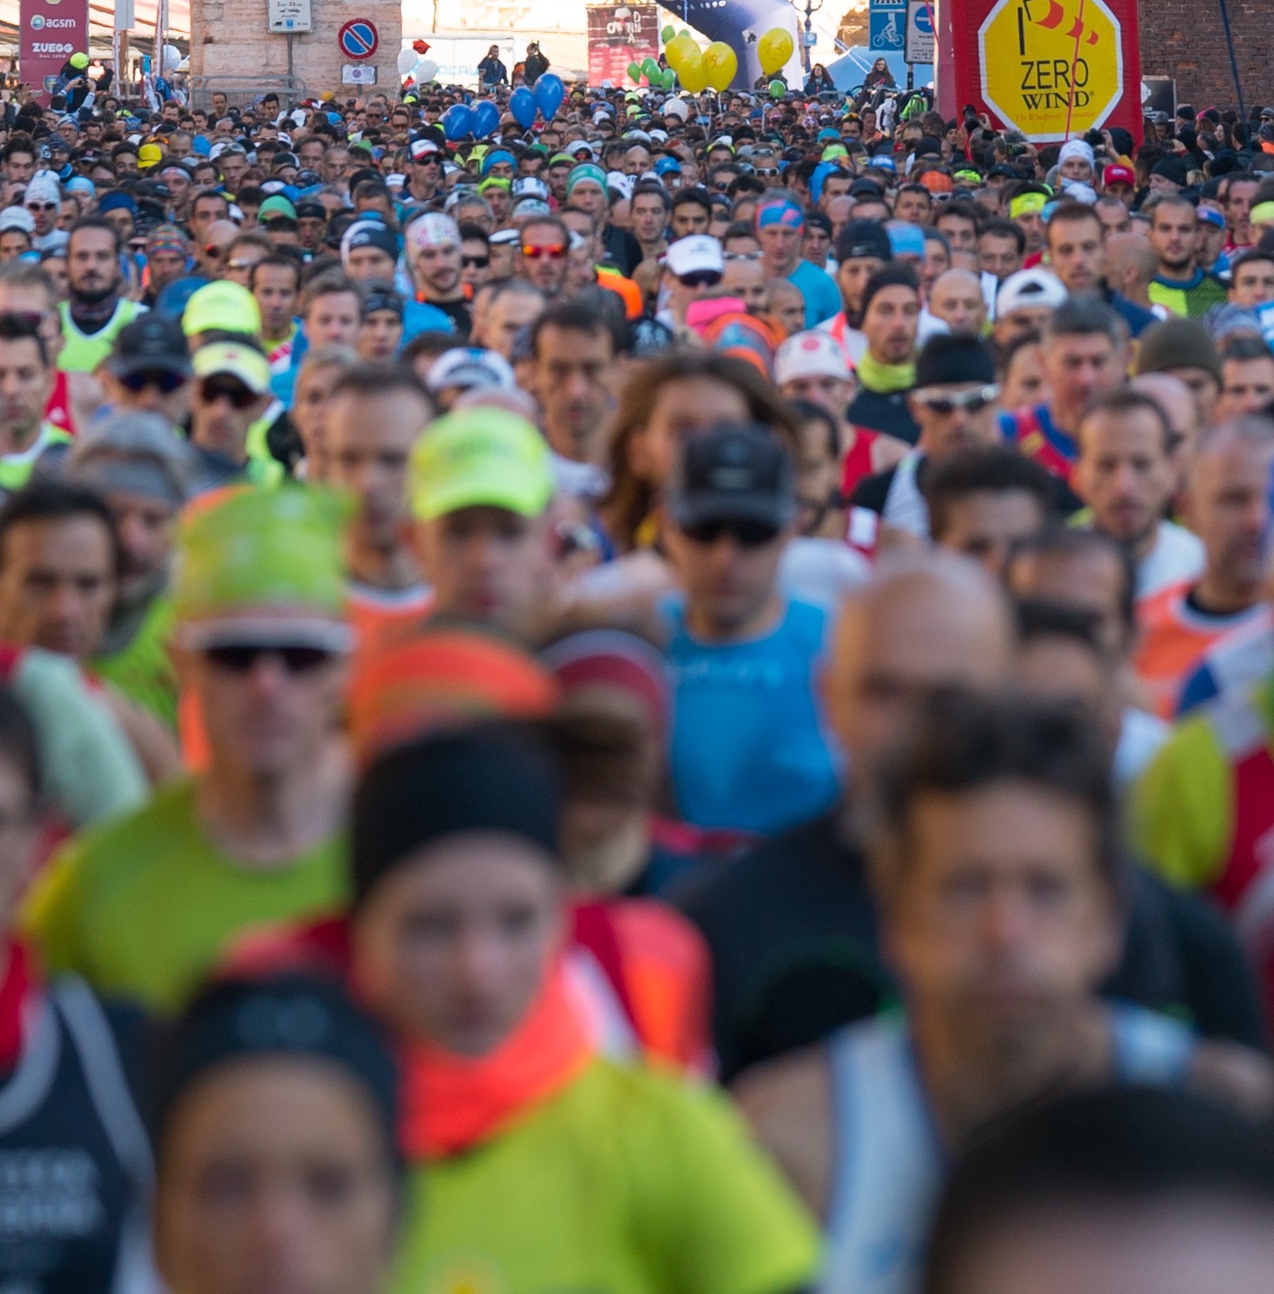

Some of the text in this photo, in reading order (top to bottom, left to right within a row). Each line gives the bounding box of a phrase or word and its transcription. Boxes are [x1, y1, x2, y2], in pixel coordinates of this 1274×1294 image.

[32, 42, 73, 53] ZUEGG
[1021, 58, 1089, 90] ZERO
[1022, 91, 1090, 110] WIND
